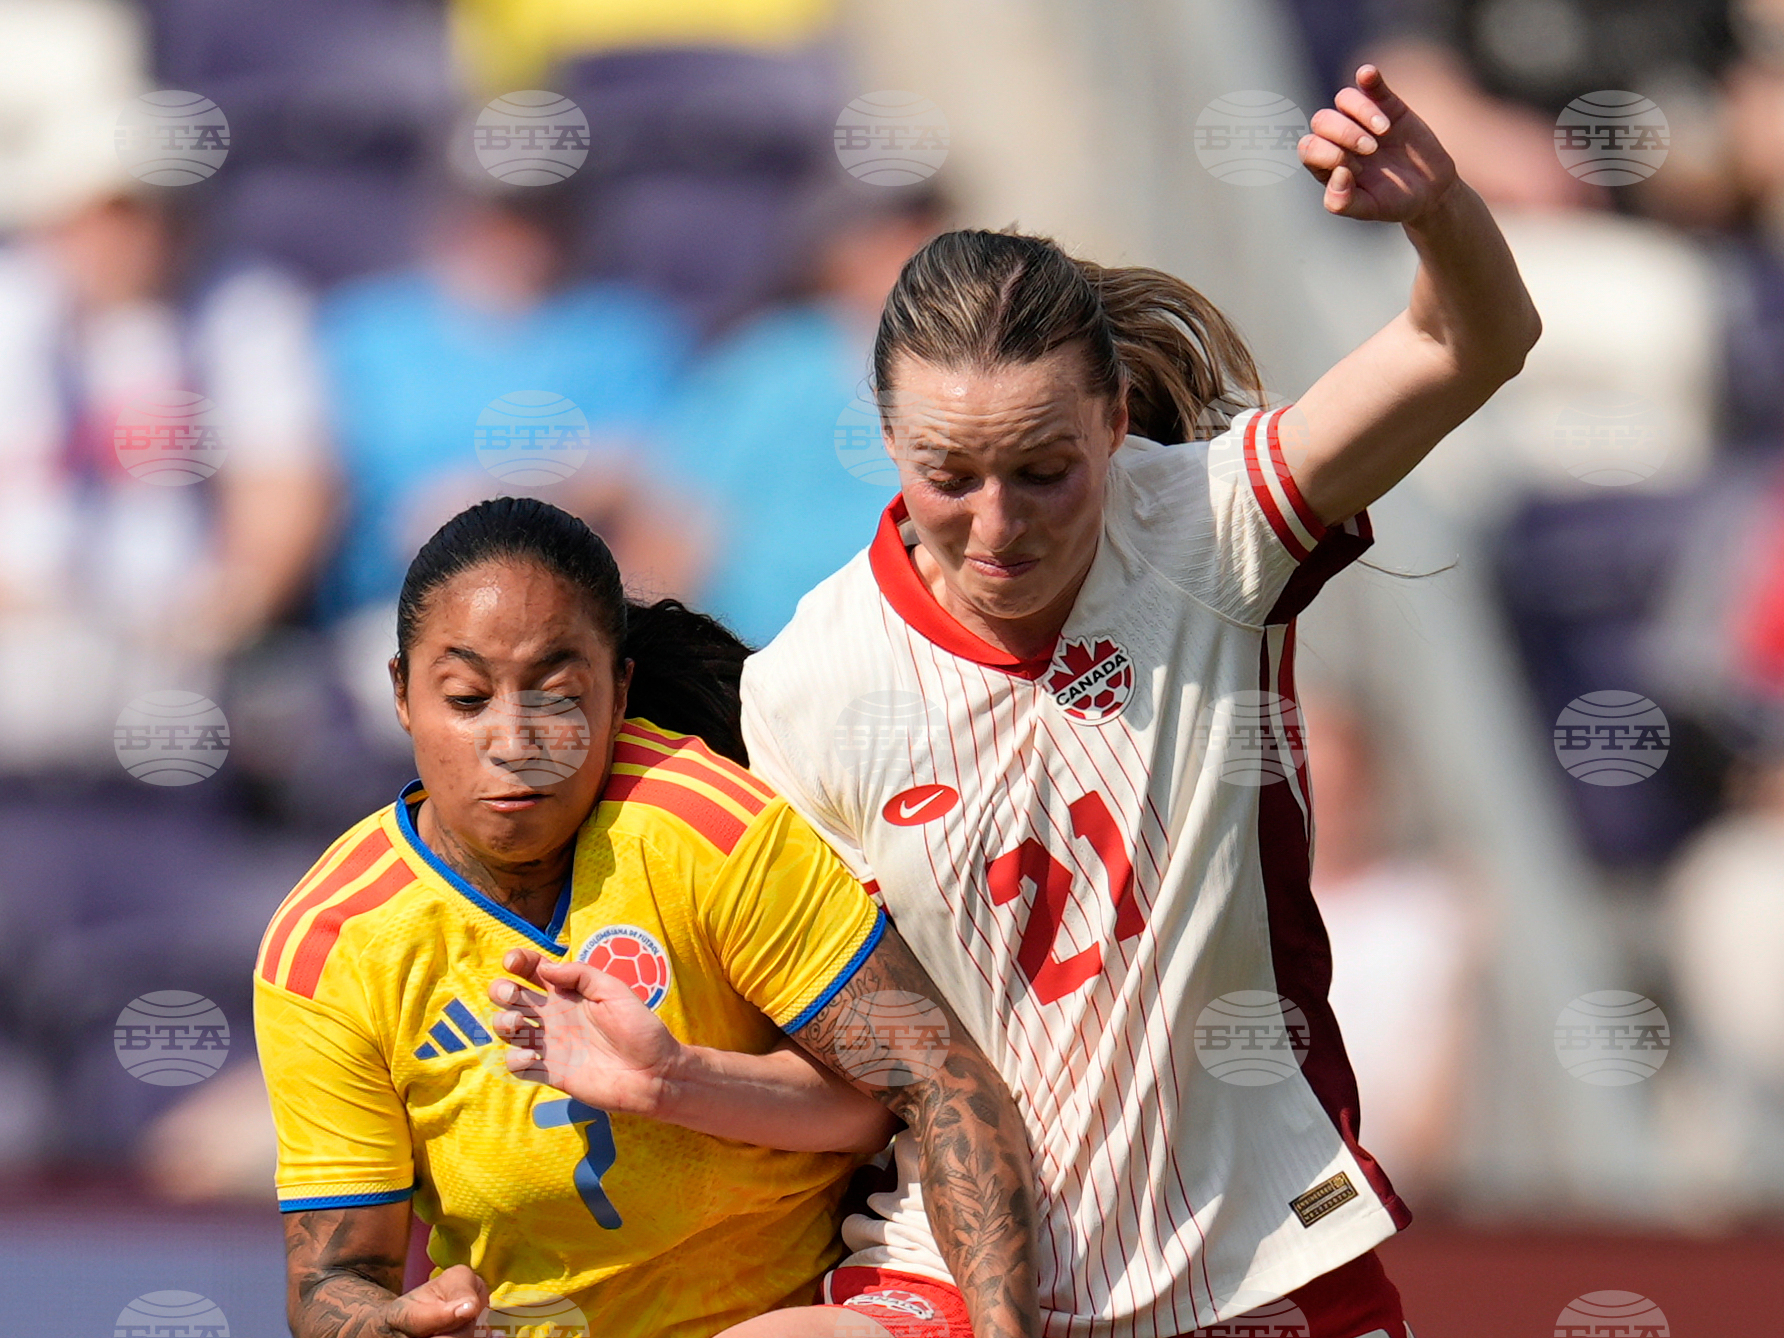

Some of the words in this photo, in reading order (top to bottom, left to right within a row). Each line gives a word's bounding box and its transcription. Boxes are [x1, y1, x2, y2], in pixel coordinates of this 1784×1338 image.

[1056, 653, 1128, 706] CANADA
[986, 790, 1146, 1006] 21
[532, 1097, 624, 1230] 7
